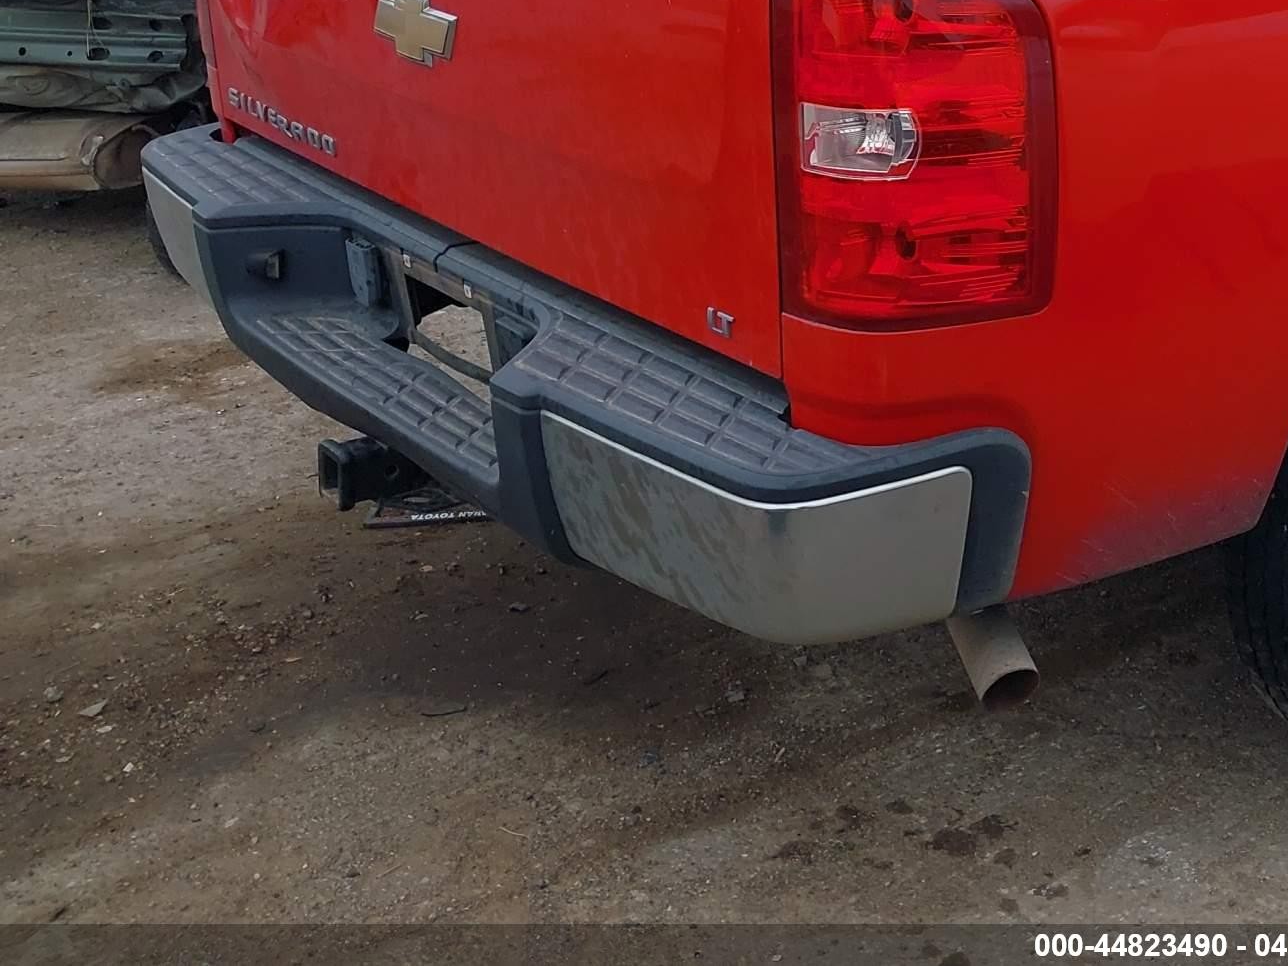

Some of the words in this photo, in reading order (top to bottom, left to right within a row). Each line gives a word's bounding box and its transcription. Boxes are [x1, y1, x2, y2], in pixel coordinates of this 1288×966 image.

[228, 87, 336, 157] SILVERADO
[707, 306, 734, 338] LT
[410, 512, 455, 521] TOYOTA
